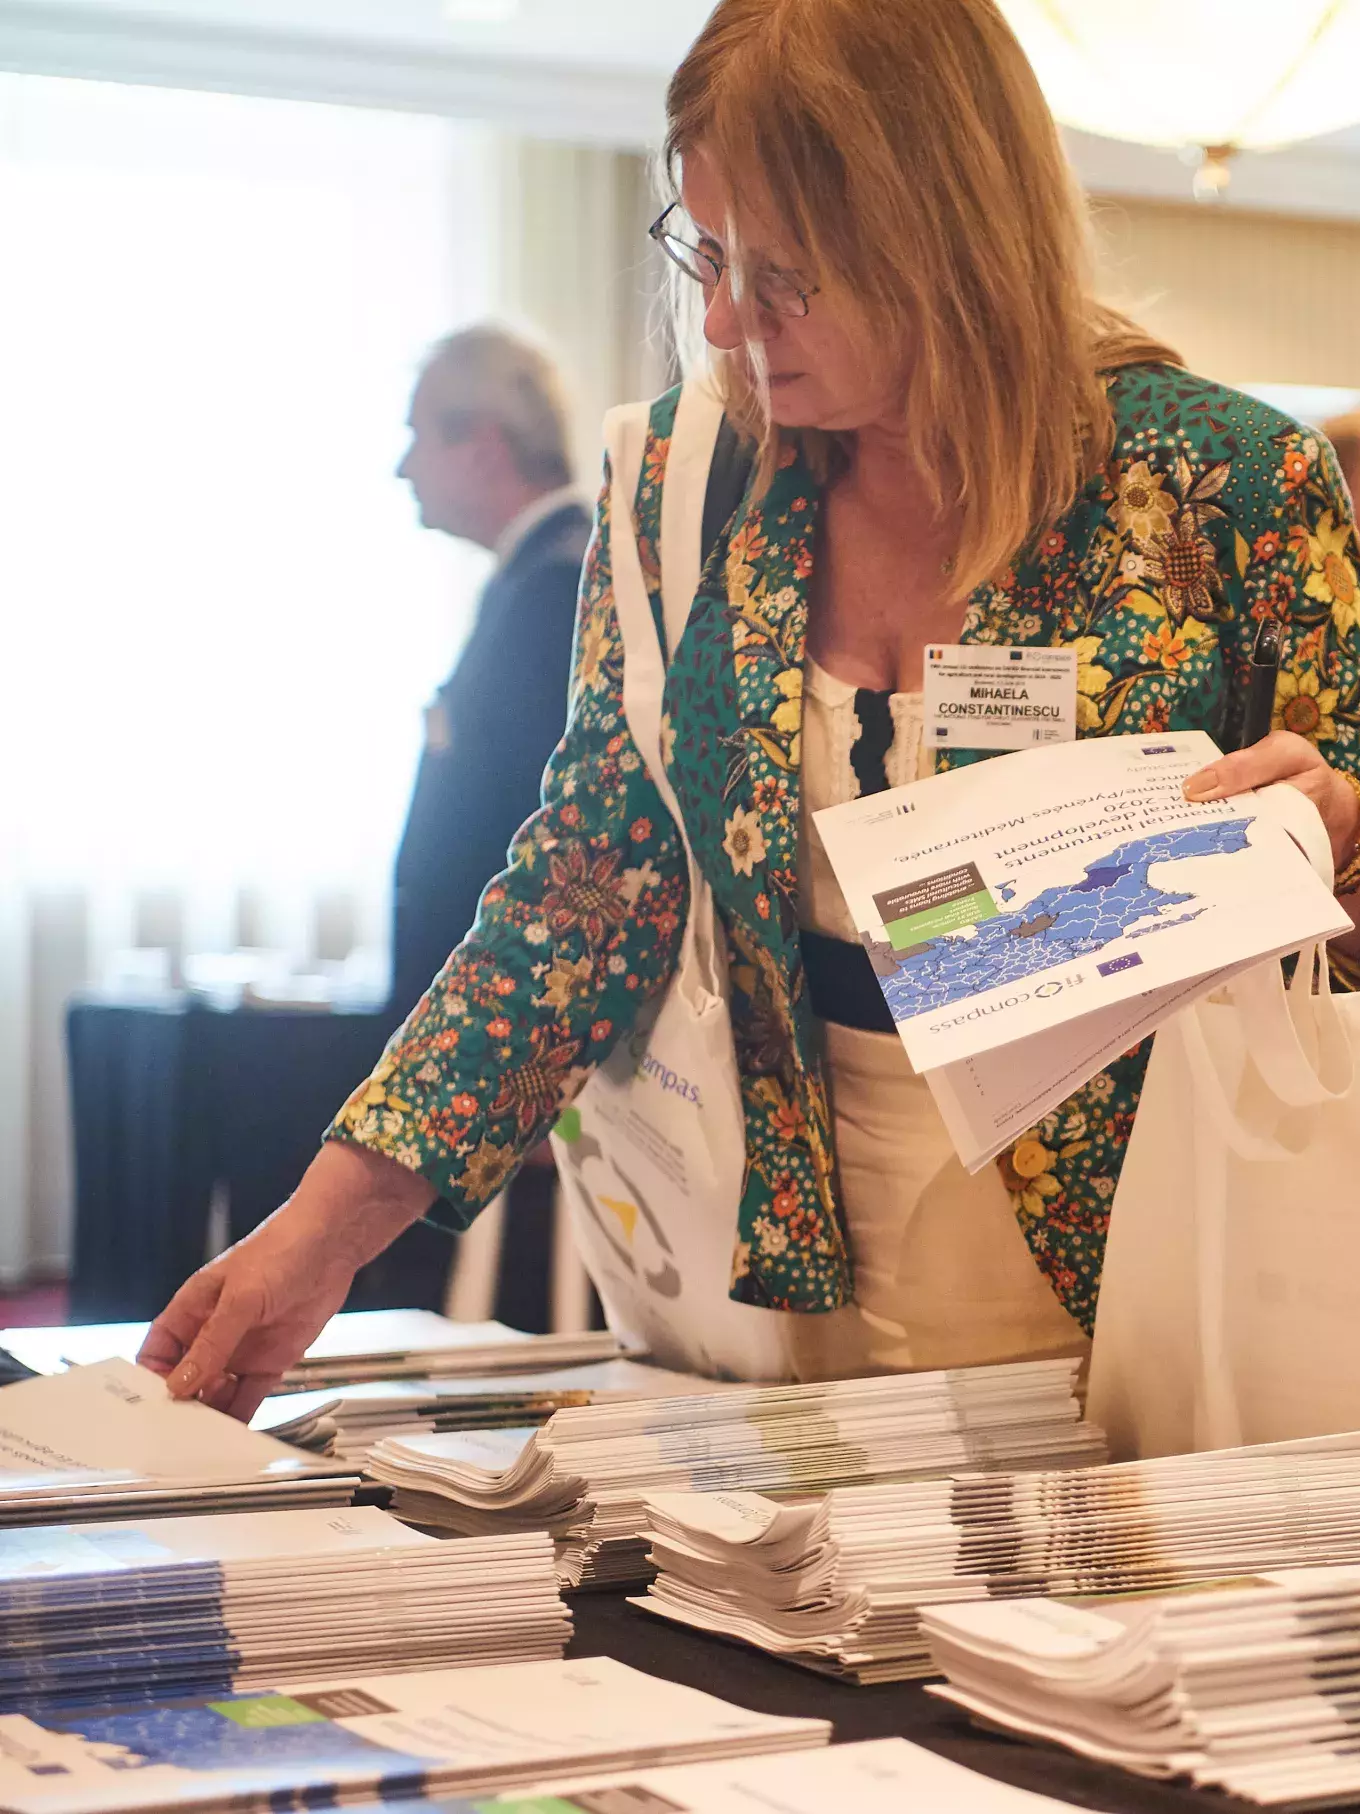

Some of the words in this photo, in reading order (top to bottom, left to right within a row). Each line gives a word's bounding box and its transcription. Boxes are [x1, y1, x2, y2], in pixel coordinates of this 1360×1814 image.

[970, 687, 1029, 700] MIHAELA
[939, 703, 1060, 717] CONSTANTINESCU
[1145, 774, 1189, 783] ance
[1139, 805, 1236, 829] Financial
[1142, 802, 1192, 820] rural
[993, 811, 1136, 860] development
[1003, 823, 1134, 870] instruments
[926, 868, 968, 885] conditions
[952, 873, 970, 883] with
[926, 878, 972, 899] agricultural
[930, 880, 951, 890] more
[887, 887, 929, 906] favourable
[905, 894, 926, 904] SMEs
[932, 886, 967, 902] enabling
[909, 897, 931, 910] loans
[929, 993, 1030, 1034] compass
